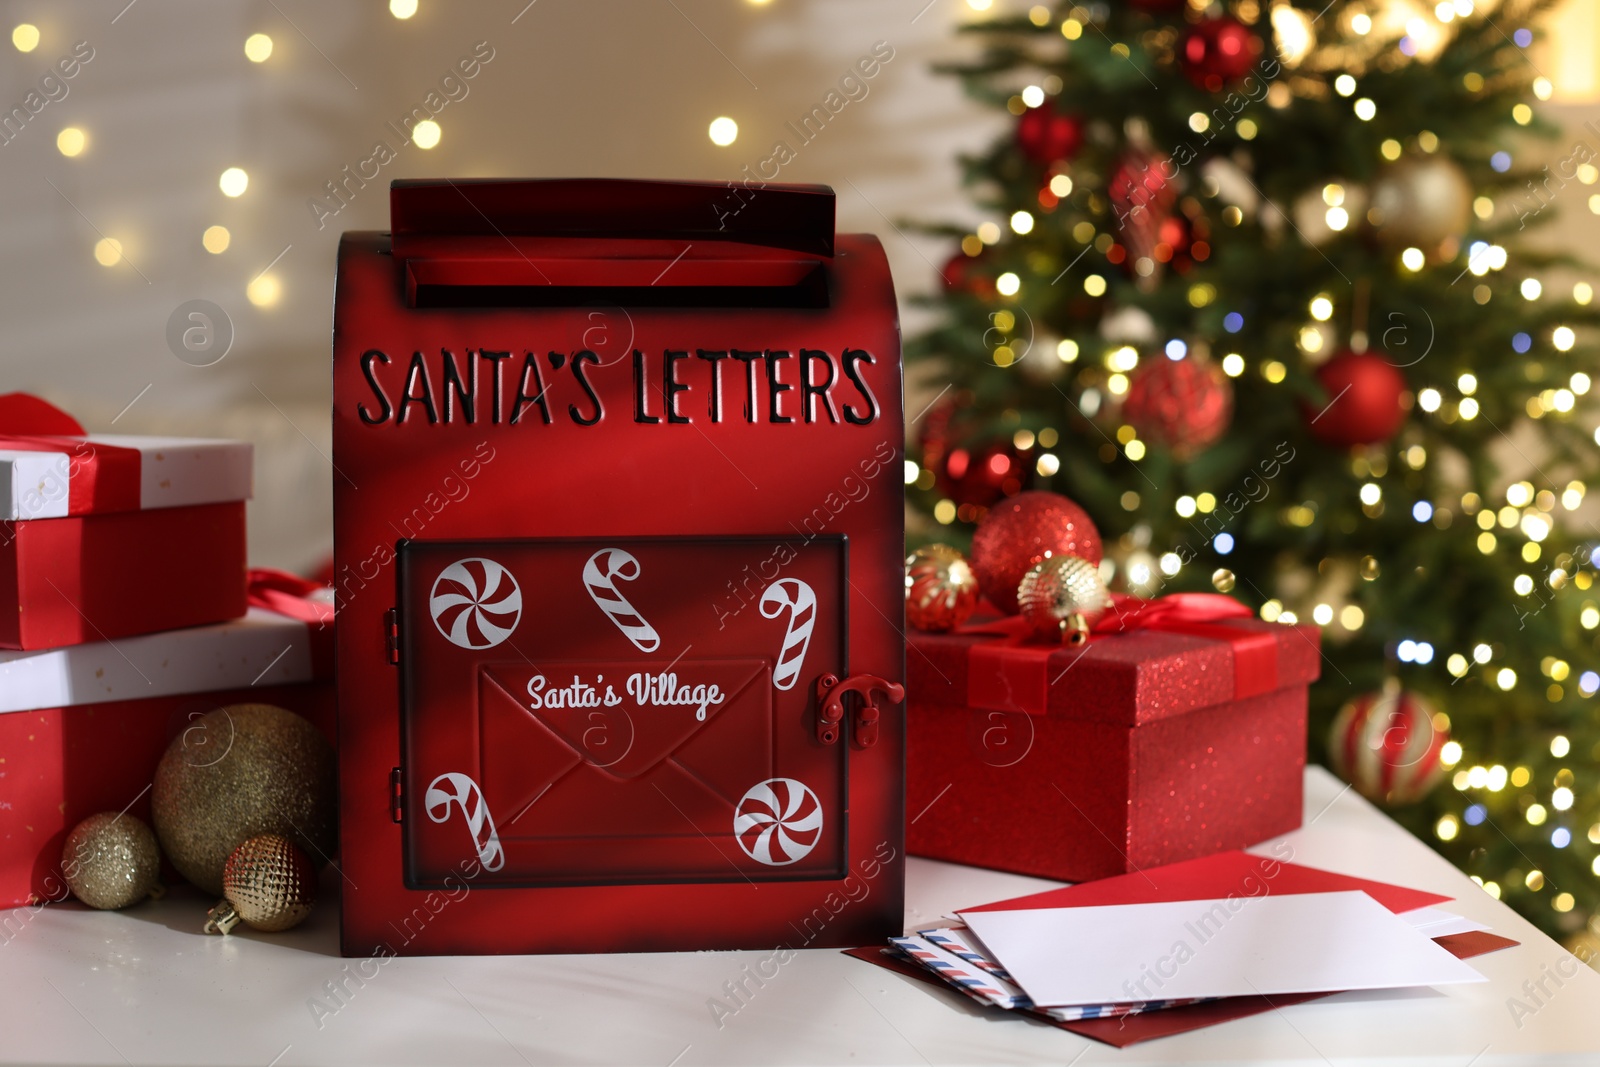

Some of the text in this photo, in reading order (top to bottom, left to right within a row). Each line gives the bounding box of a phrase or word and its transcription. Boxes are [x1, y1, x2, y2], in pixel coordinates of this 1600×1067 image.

[357, 348, 880, 426] SANTA'S LETTERS
[527, 672, 725, 721] Santa's Village
